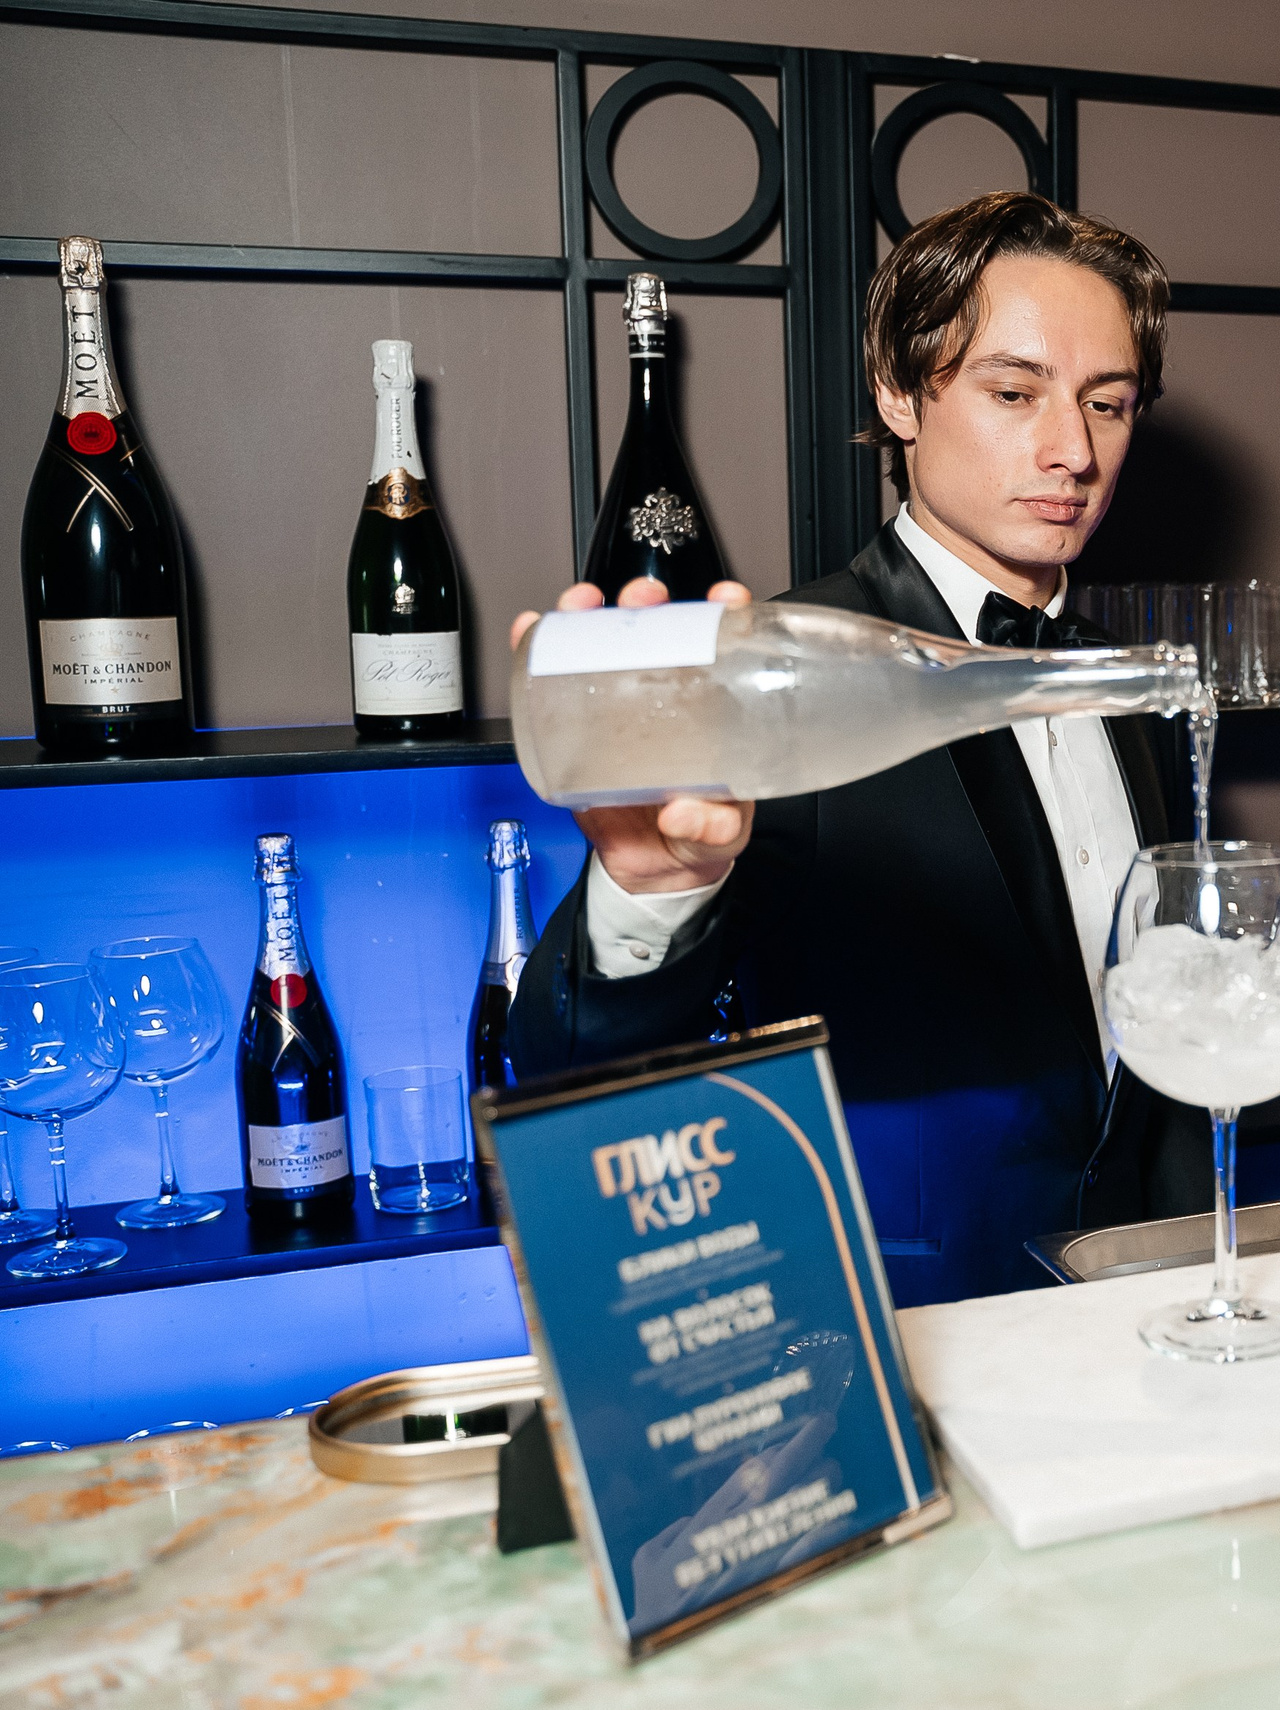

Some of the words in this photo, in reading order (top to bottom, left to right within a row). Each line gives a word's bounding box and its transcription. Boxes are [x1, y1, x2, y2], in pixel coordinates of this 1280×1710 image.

[69, 629, 151, 643] CHAMPAGNE
[93, 665, 101, 676] &
[104, 660, 172, 676] CHANDON
[362, 659, 398, 682] Pol
[396, 659, 453, 689] Roger
[102, 705, 131, 714] BRUT
[296, 1148, 344, 1165] CHANDON
[627, 1170, 722, 1236] КУР
